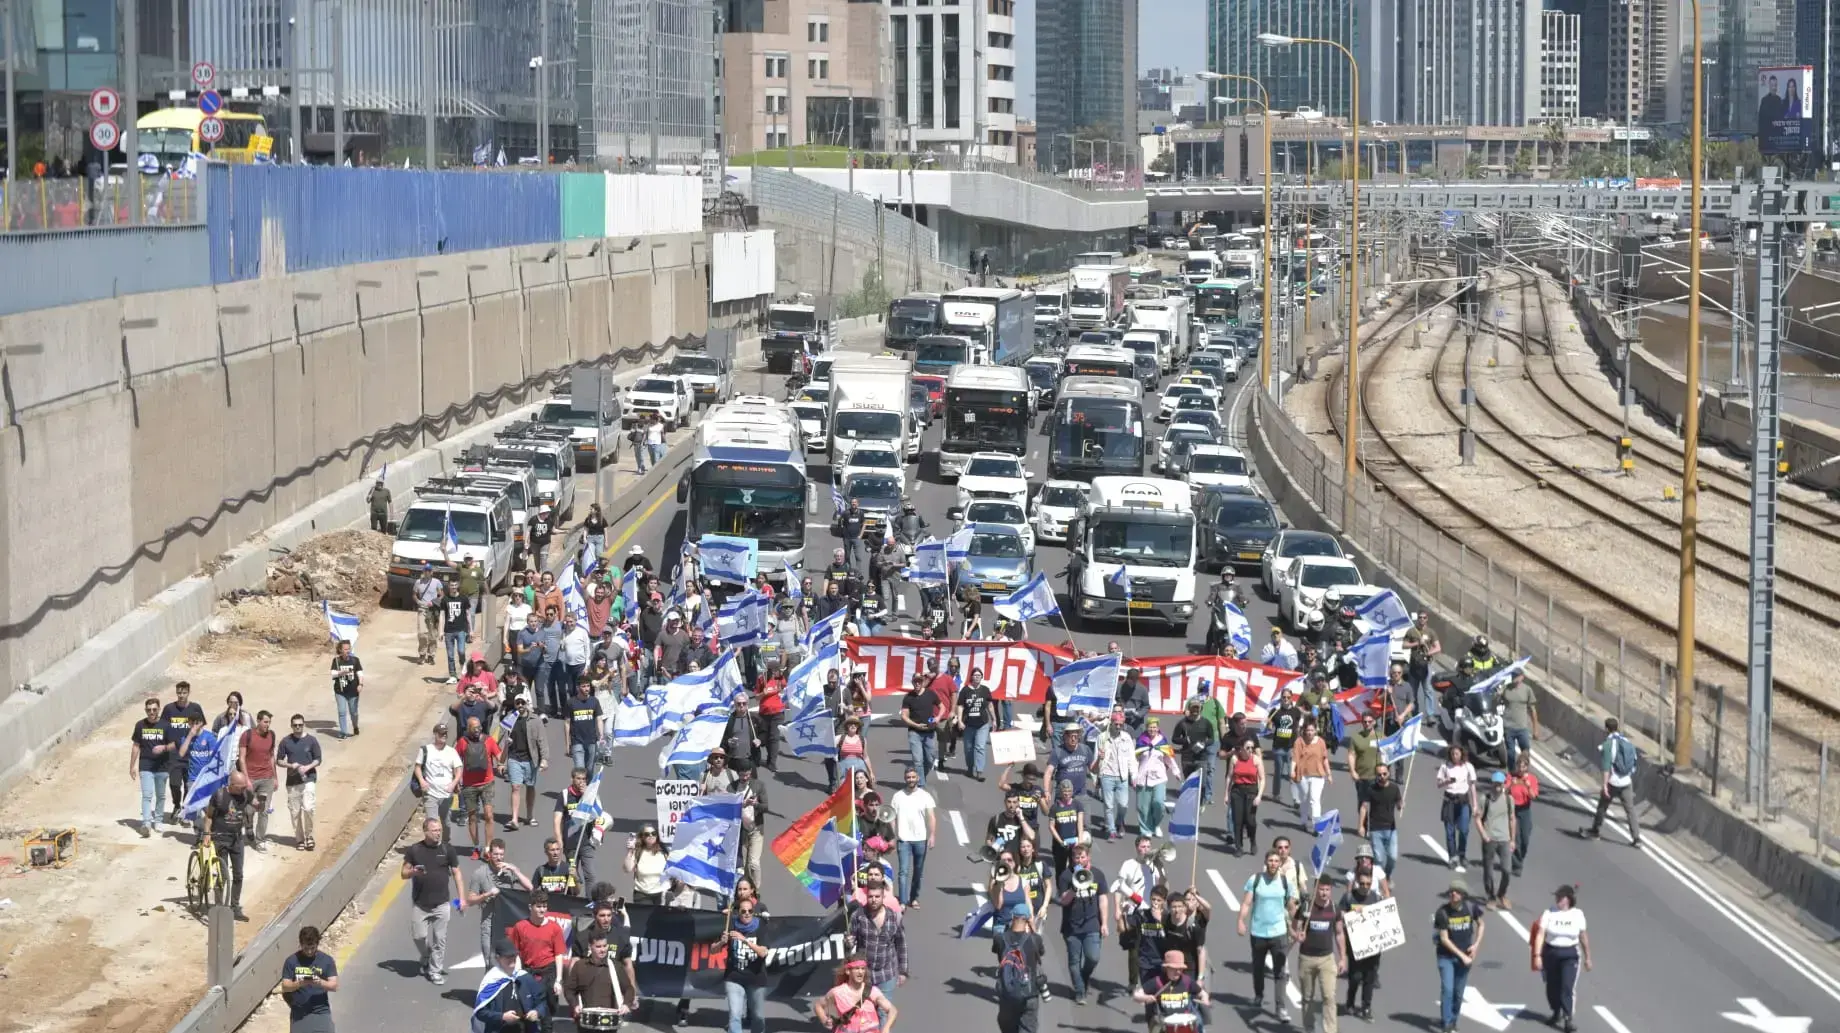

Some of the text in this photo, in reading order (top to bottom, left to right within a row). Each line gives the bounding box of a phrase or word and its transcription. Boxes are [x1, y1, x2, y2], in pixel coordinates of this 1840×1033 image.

[855, 645, 1074, 699] יקטטורה
[1118, 663, 1279, 720] להתנג
[629, 936, 686, 966] מועד
[691, 943, 729, 971] אין
